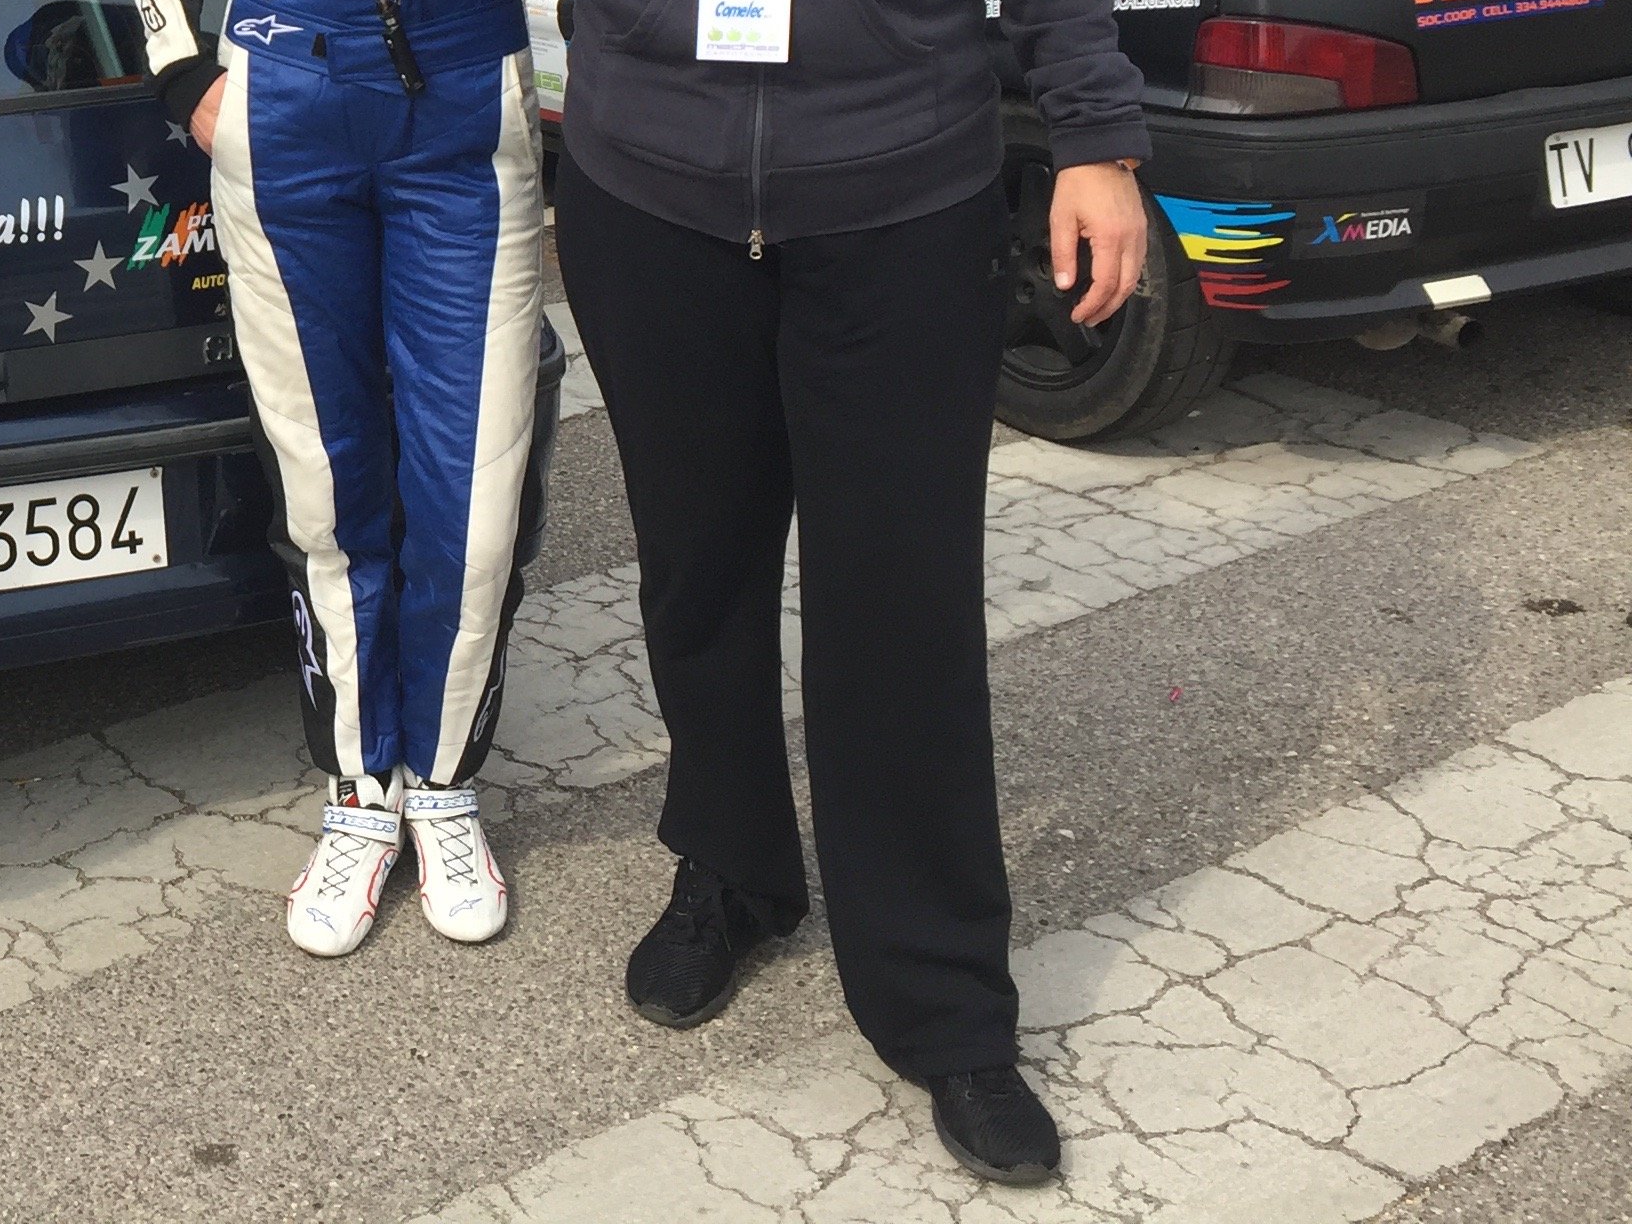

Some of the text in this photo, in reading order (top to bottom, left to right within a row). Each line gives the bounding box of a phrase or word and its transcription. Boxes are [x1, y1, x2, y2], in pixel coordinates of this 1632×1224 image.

[1548, 137, 1595, 198] TV
[132, 227, 216, 262] ZAM
[191, 273, 226, 291] AUTO
